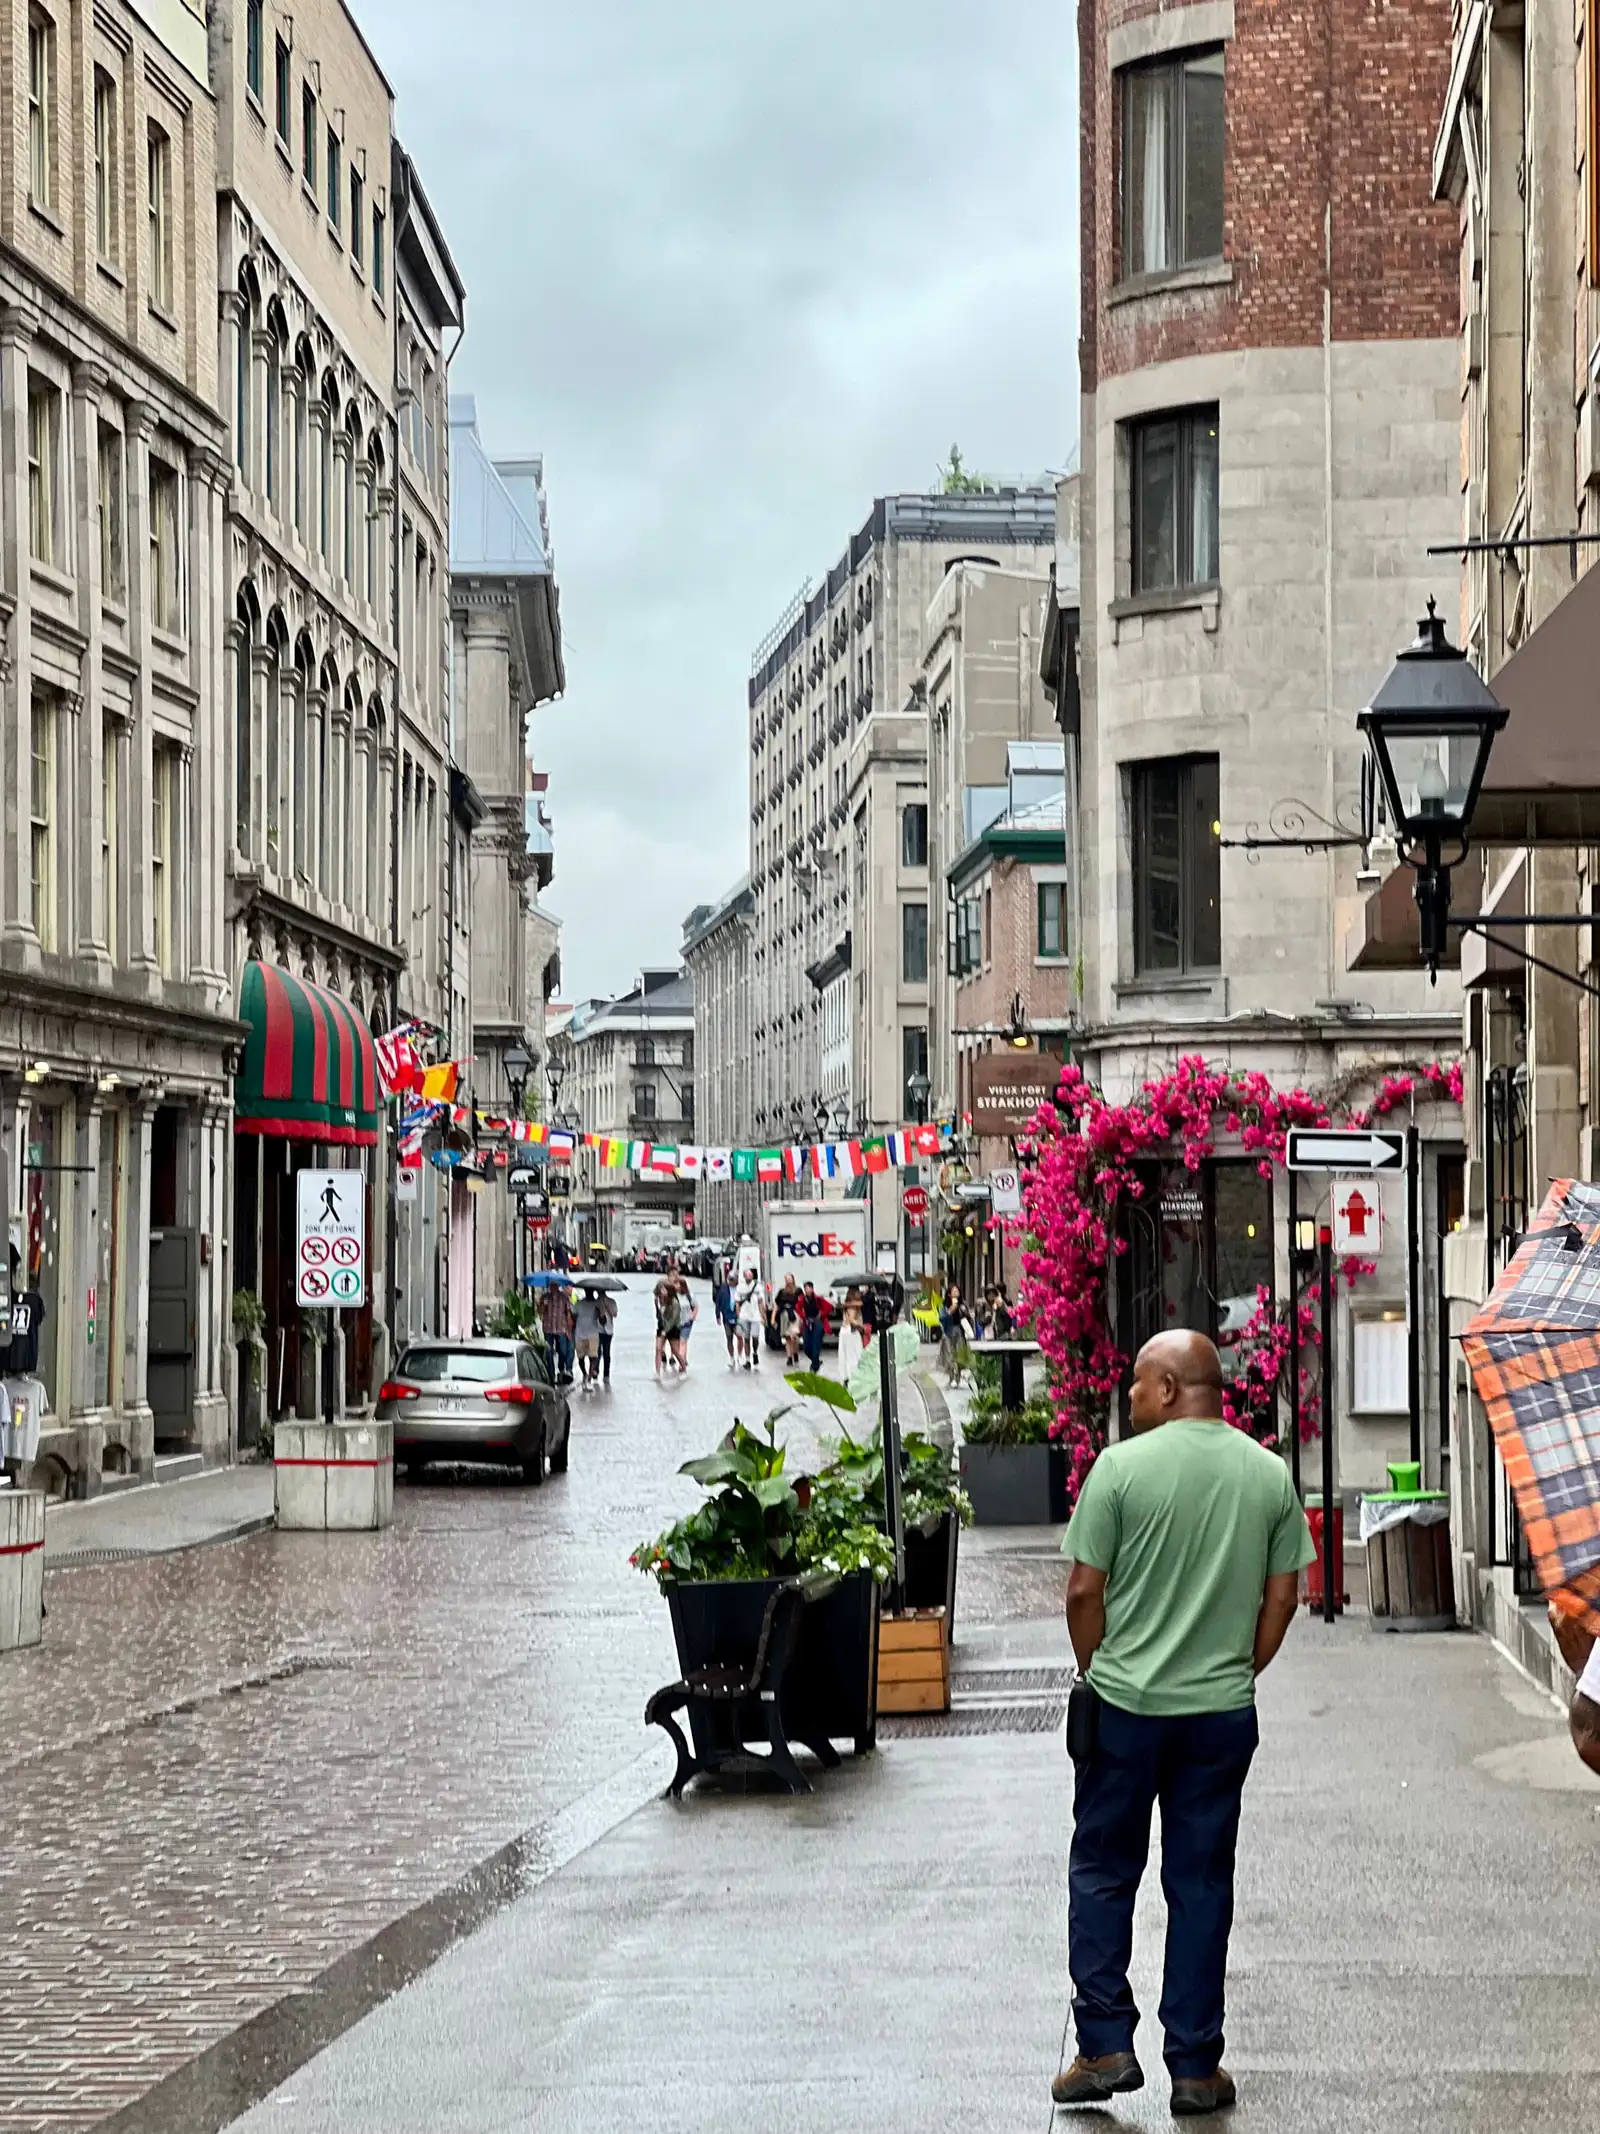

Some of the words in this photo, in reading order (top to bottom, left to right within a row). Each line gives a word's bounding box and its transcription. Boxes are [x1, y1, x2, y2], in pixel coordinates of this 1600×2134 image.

[988, 1085, 1018, 1095] VIEUX
[1021, 1085, 1046, 1095] PORT
[977, 1096, 1044, 1109] STEAKHOU
[1160, 1201, 1203, 1211] STEAKHOUSE
[304, 1224, 321, 1234] ZONE
[324, 1223, 356, 1234] PIÉTONNE
[777, 1232, 856, 1258] FedEx
